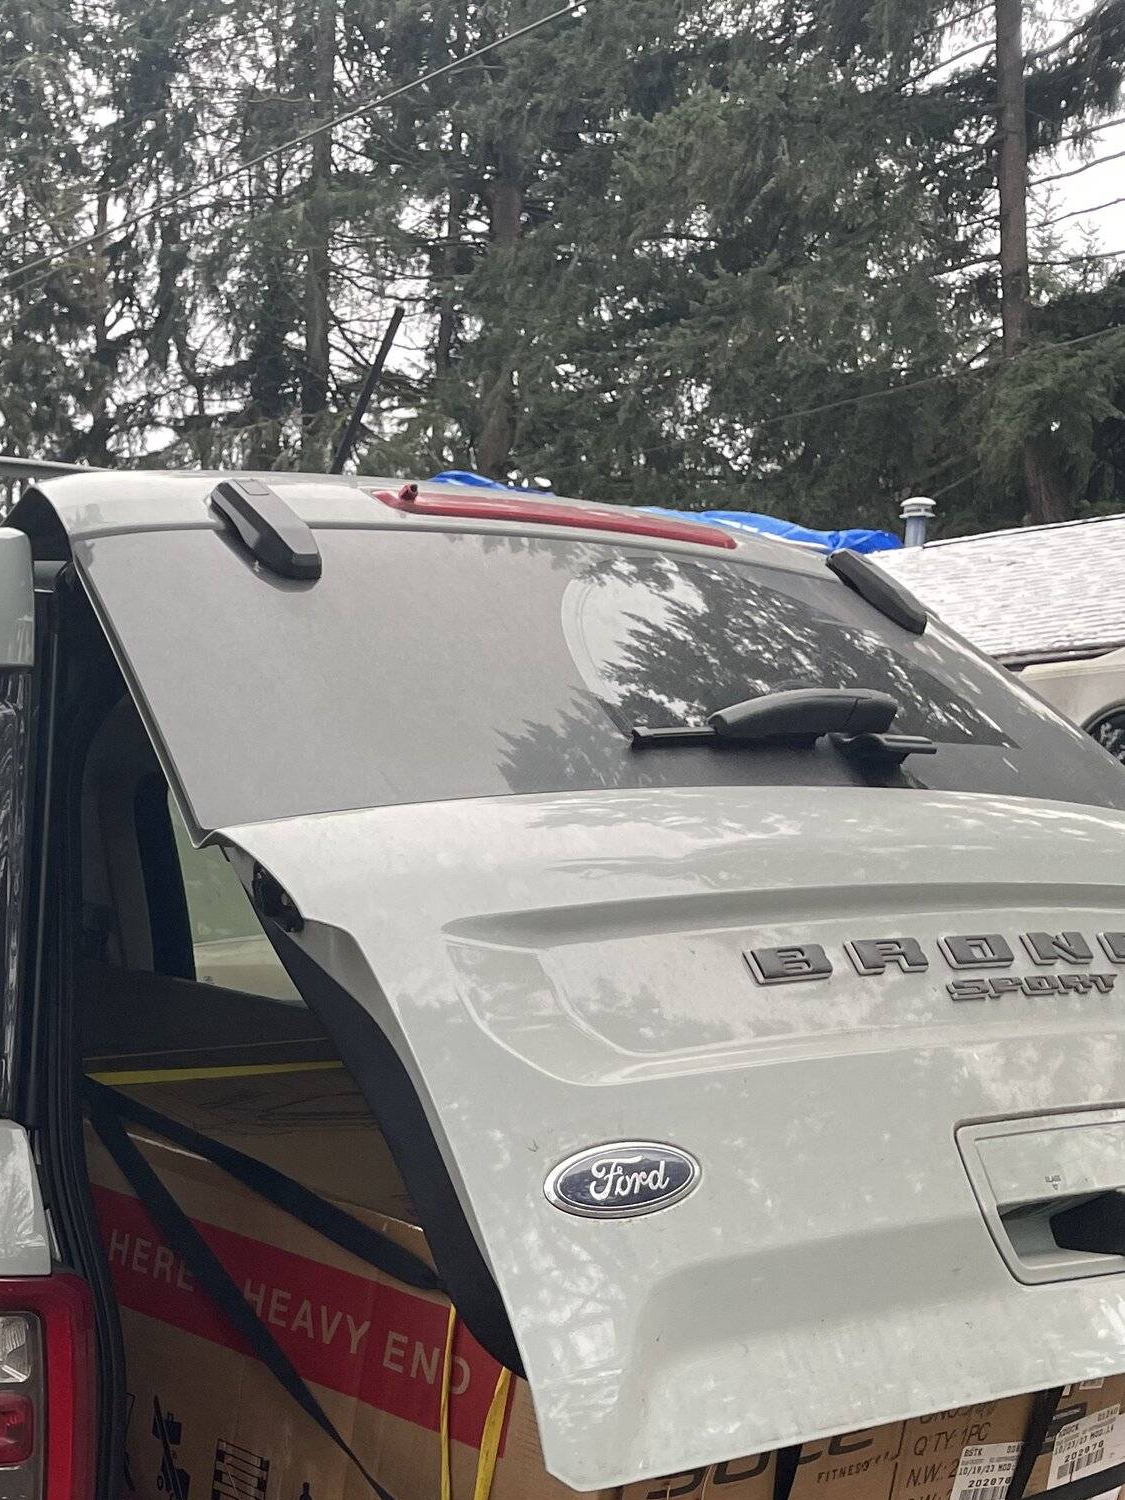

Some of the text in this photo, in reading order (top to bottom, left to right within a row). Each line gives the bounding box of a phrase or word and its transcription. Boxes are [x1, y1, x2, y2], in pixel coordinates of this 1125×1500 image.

[946, 973, 1118, 1001] SPORT
[589, 1155, 670, 1201] Ford
[109, 1228, 471, 1395] HERE HEAVY END
